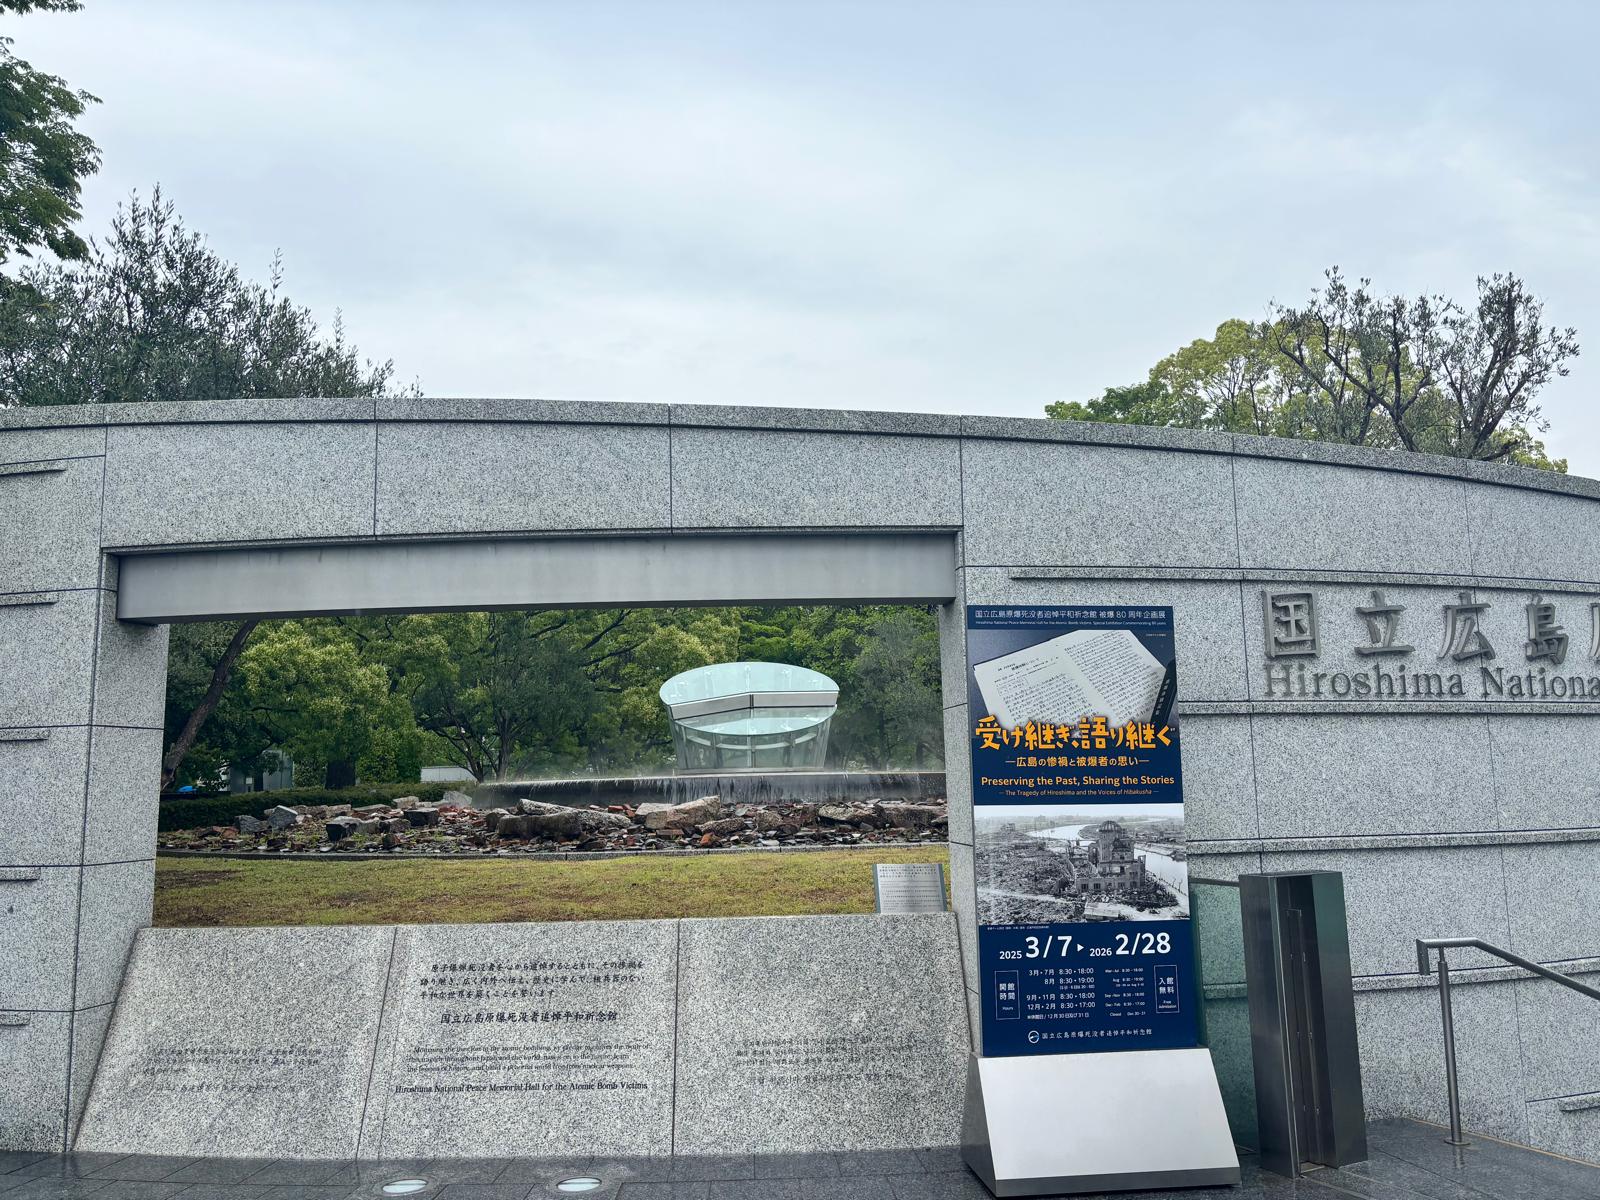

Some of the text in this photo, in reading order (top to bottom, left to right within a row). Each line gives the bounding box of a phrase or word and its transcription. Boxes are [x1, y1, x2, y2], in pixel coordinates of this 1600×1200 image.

[1116, 610, 1127, 618] 80
[1262, 589, 1600, 664] 国立広島
[1264, 662, 1467, 697] Hiroshima
[975, 715, 1176, 751] 受け継ぎ、語り継ぐ
[981, 775, 1175, 788] Preserving the Past, Sharing the Stories
[1017, 789, 1039, 797] Tragedy
[999, 932, 1171, 960] 2025 3/7 2026 2/28
[1159, 977, 1174, 985] 入館
[1000, 992, 1016, 1000] 時間
[440, 1011, 618, 1025] 国立広島原爆死没者追悼平和祈念館
[395, 1081, 648, 1093] Hiroshima National Peace Memorial Hall for the Atomic Bomb Victims
